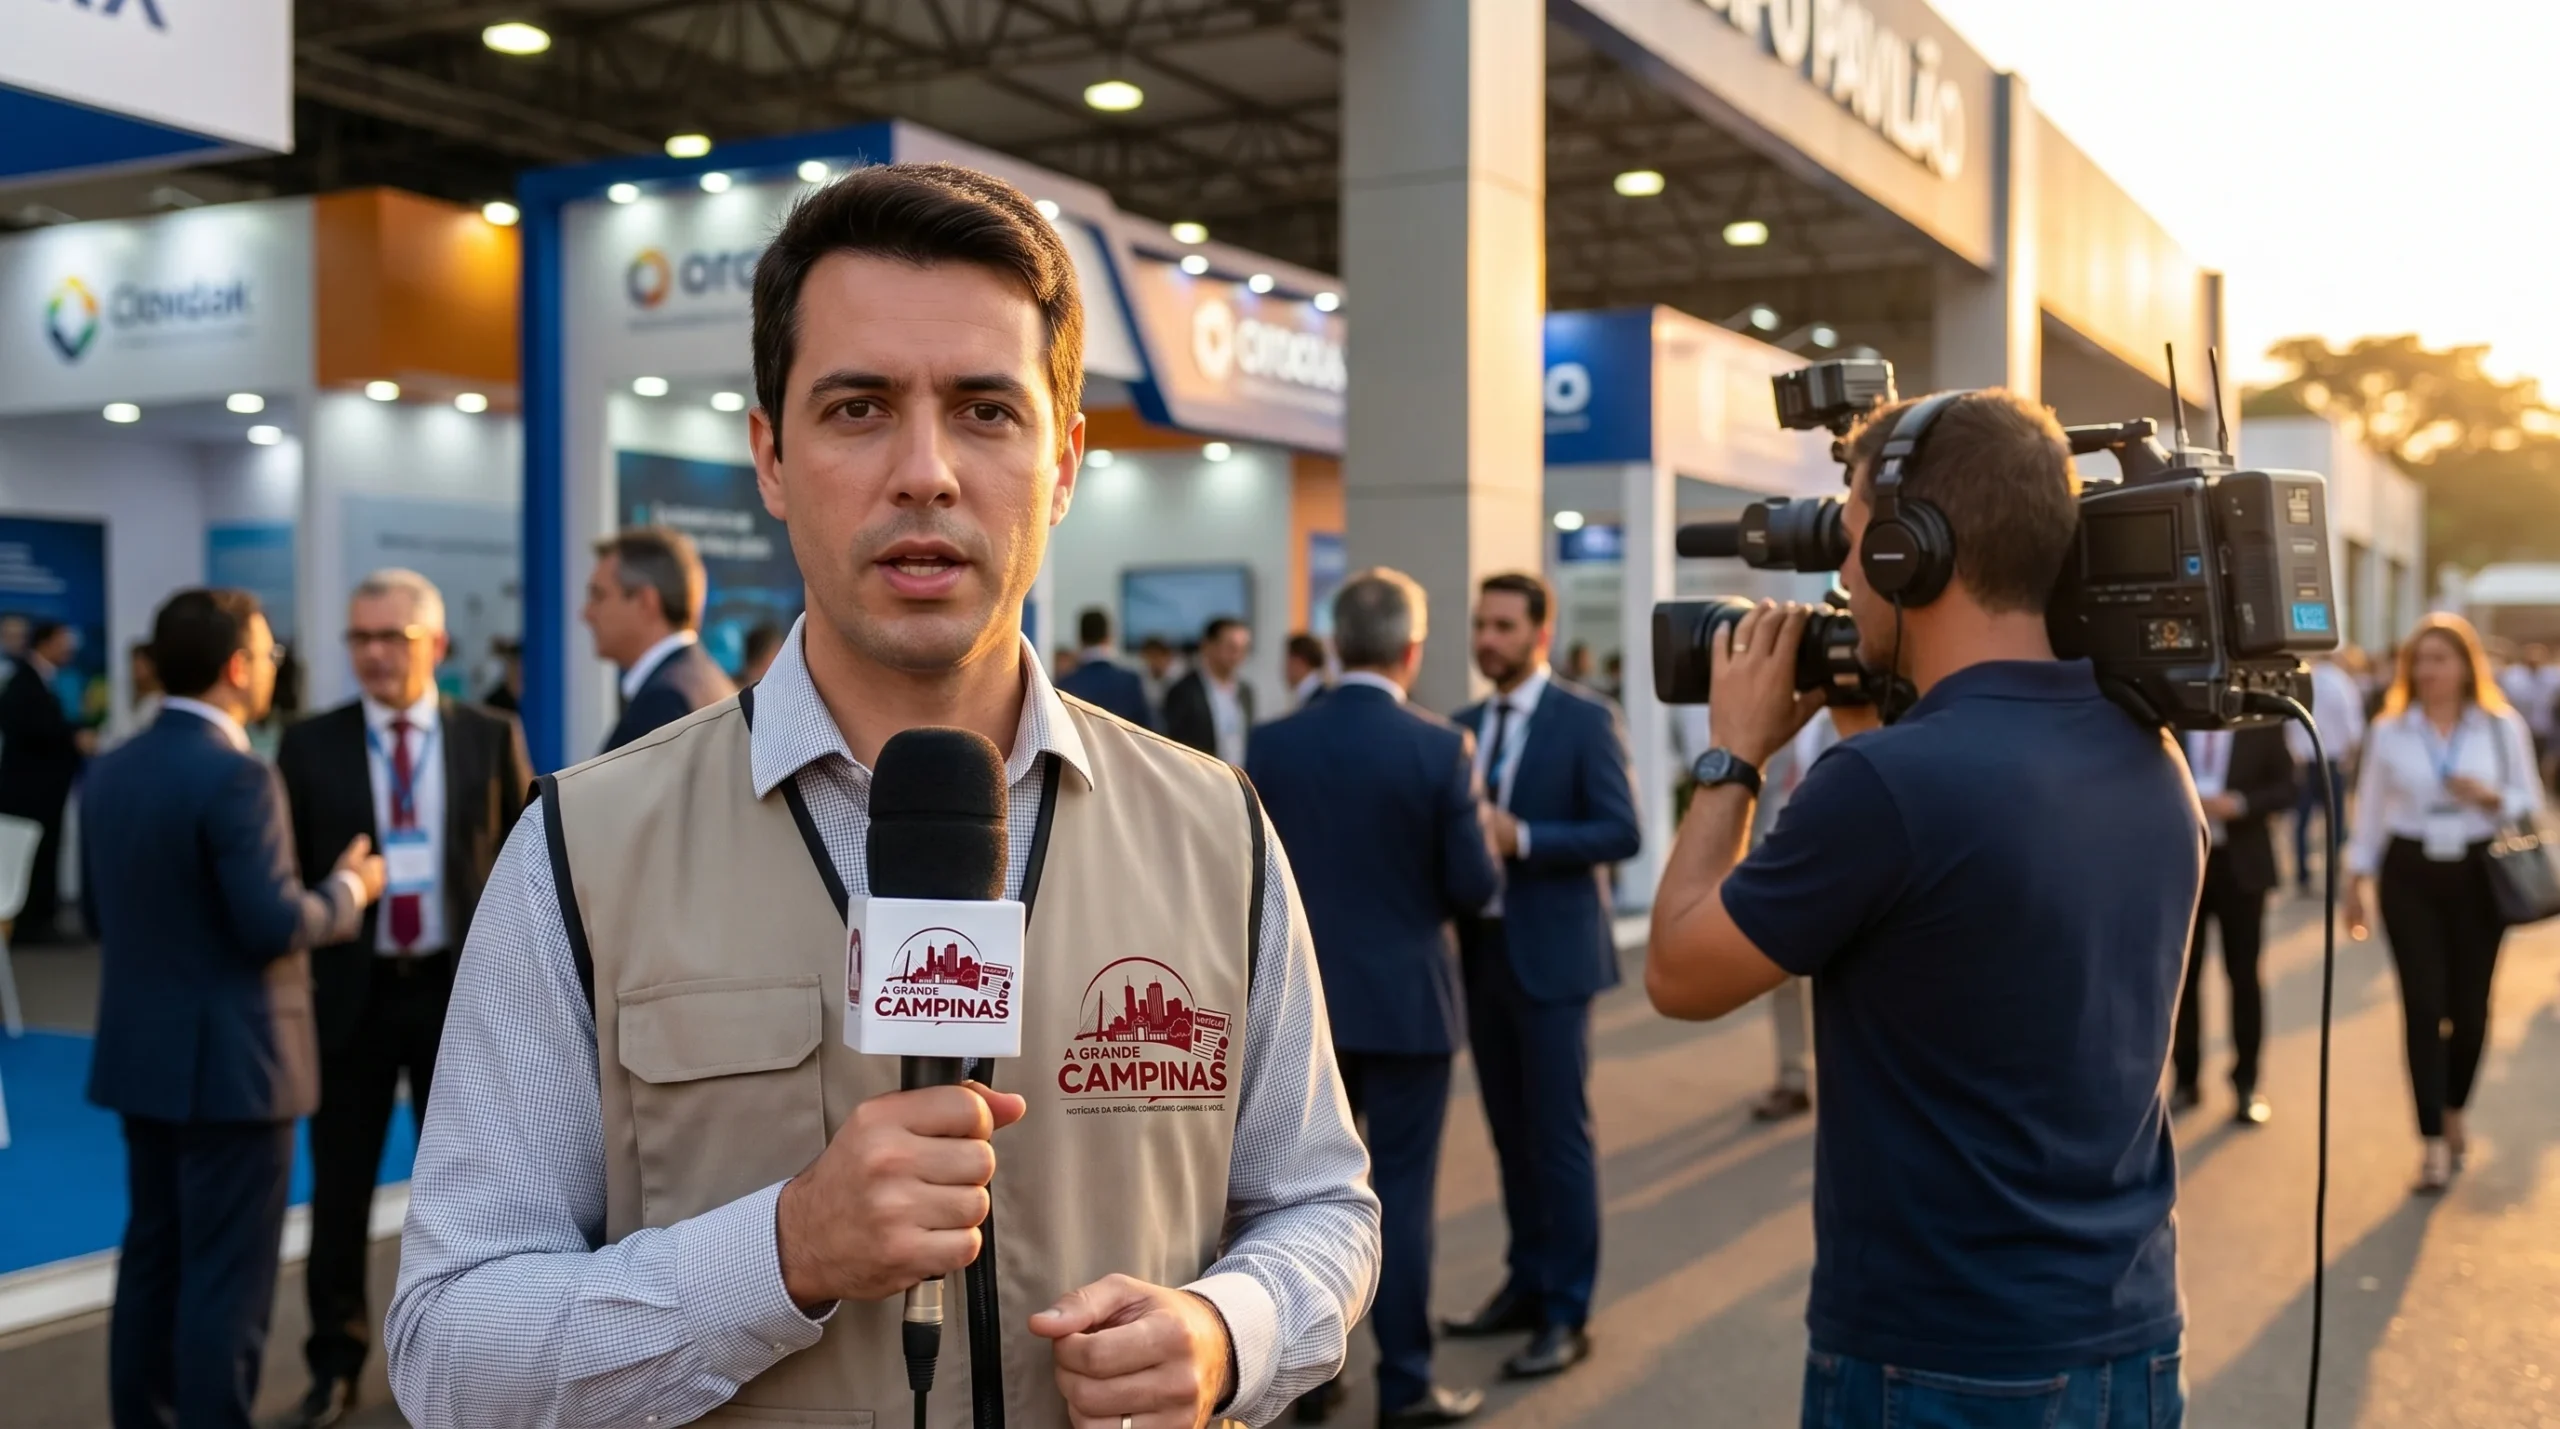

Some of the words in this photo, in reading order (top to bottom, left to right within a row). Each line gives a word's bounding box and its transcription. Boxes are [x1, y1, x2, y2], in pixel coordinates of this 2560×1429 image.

[880, 985, 889, 995] A
[892, 986, 940, 996] GRANDE
[874, 996, 1010, 1019] CAMPINAS
[1063, 1047, 1075, 1061] A
[1079, 1046, 1141, 1060] GRANDE
[1057, 1061, 1228, 1094] CAMPINAS
[1066, 1105, 1100, 1115] NOTÍCIAS
[1101, 1105, 1112, 1114] DA
